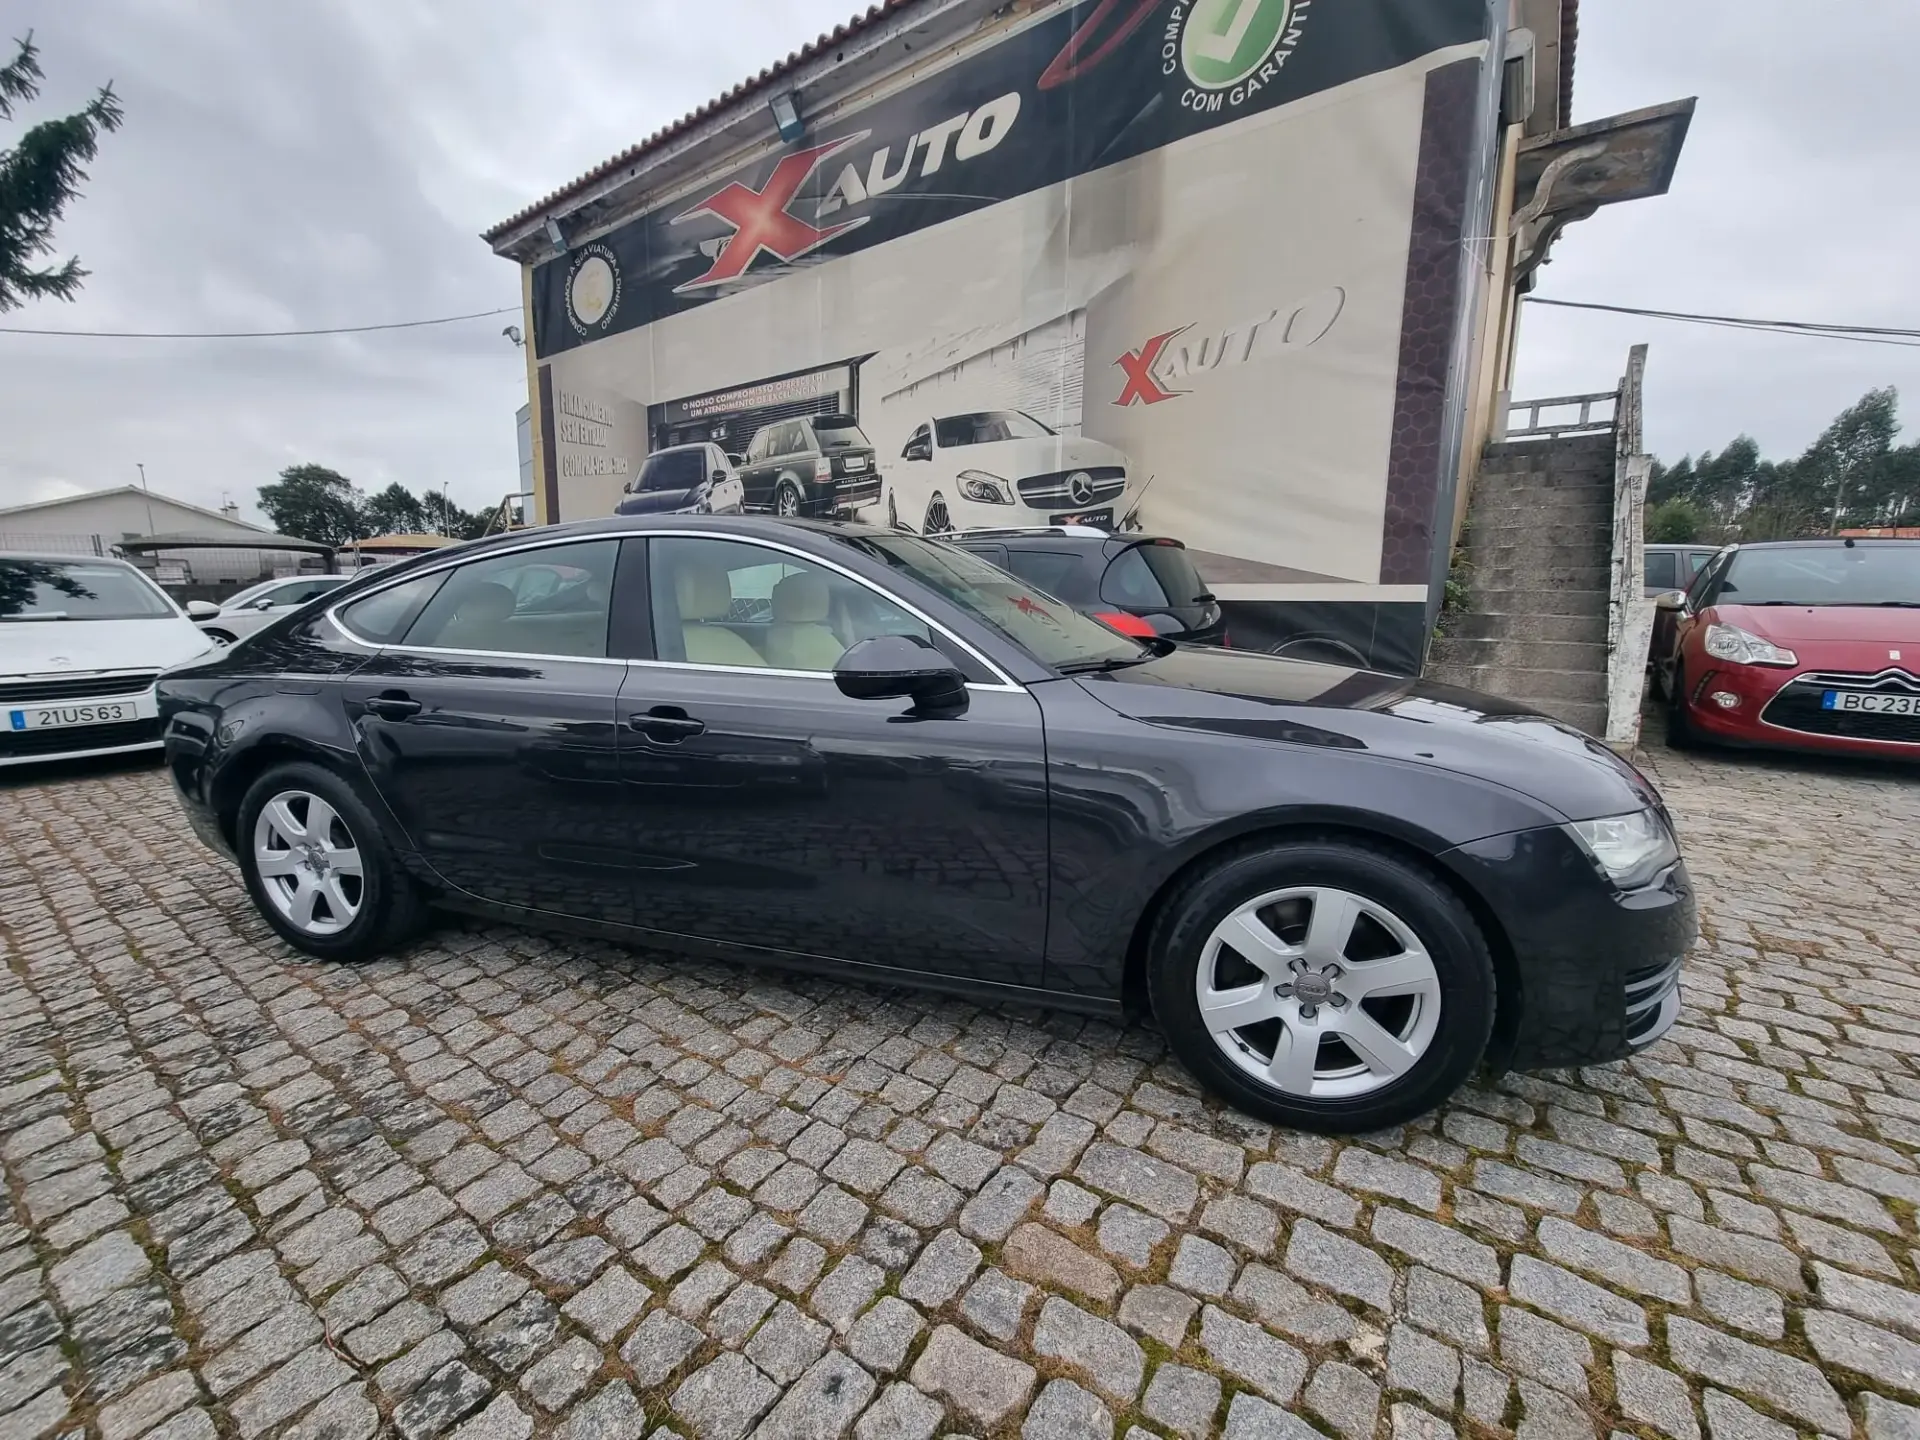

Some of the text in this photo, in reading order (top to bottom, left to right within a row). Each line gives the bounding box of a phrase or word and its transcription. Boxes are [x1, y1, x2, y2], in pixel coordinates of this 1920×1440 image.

[1181, 88, 1224, 112] COM
[682, 402, 689, 411] O
[689, 397, 714, 409] NOSSO
[716, 384, 774, 403] COMPROMISSO
[690, 409, 702, 418] UM
[703, 398, 755, 415] ATENDIMENTO
